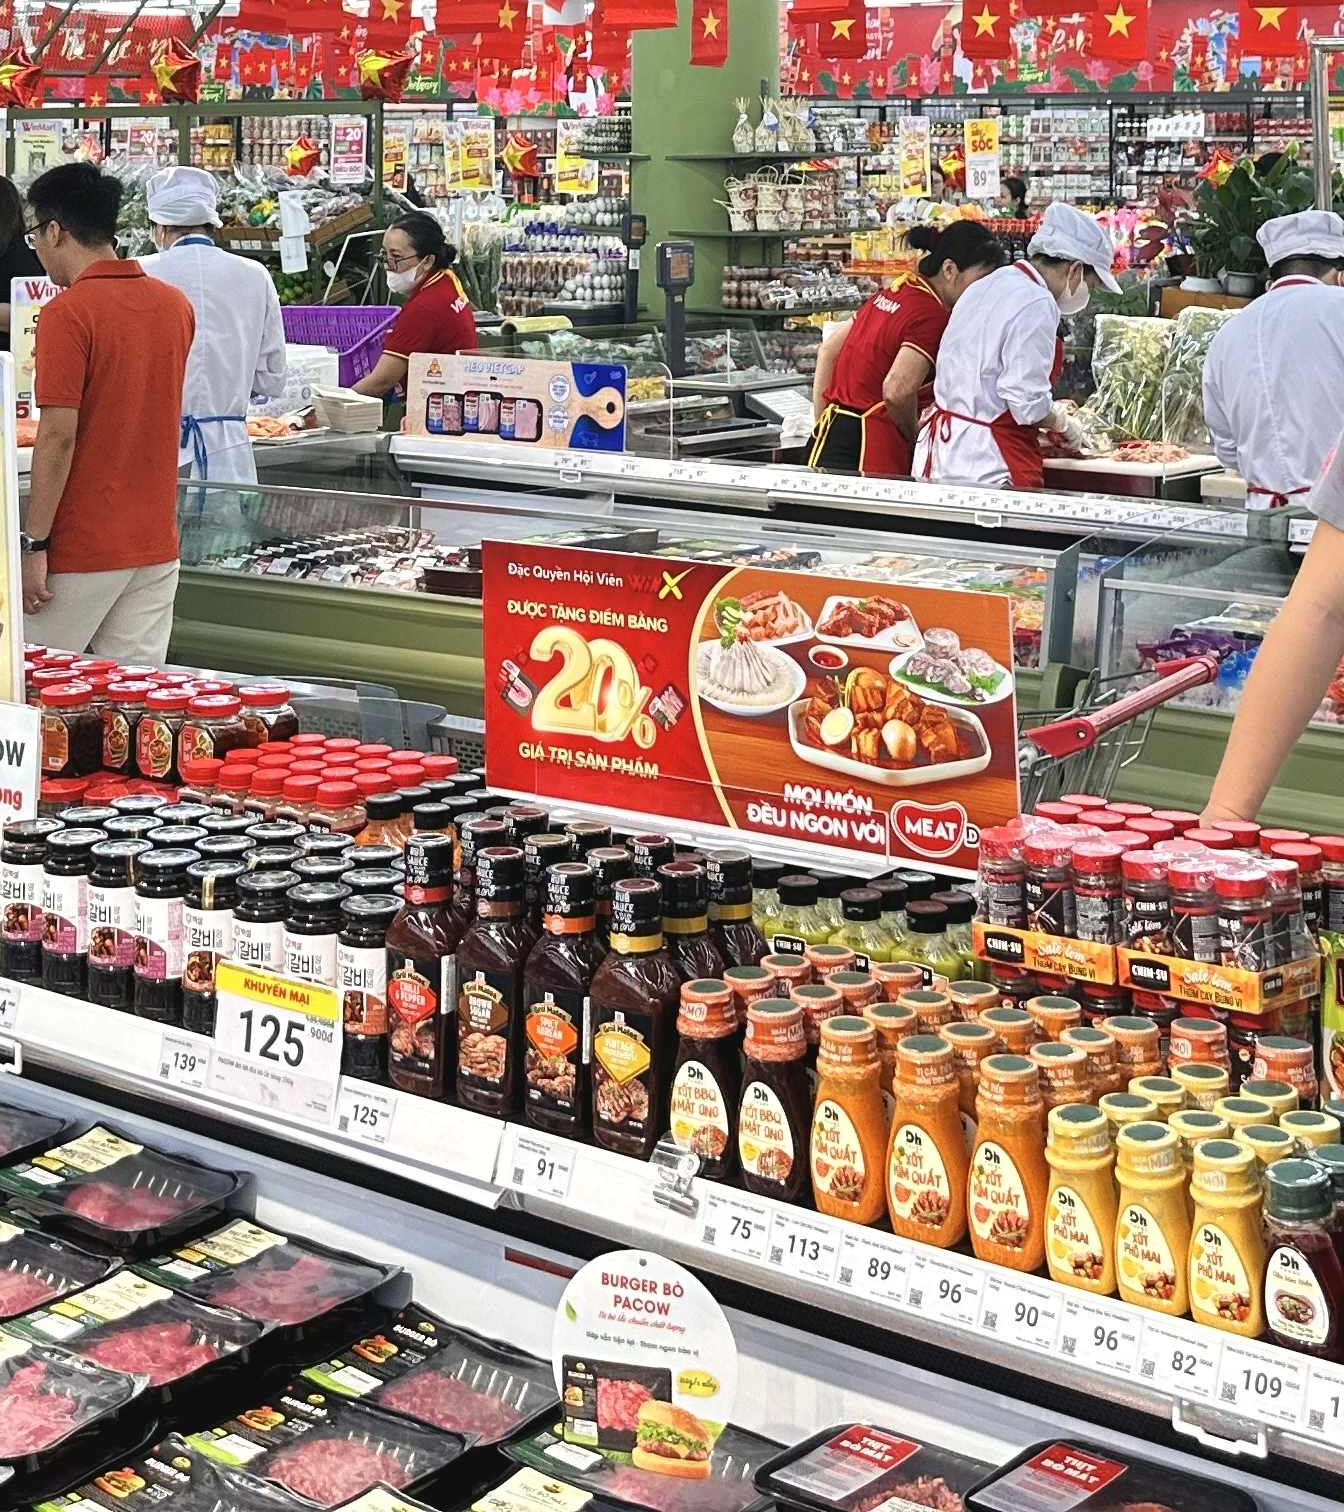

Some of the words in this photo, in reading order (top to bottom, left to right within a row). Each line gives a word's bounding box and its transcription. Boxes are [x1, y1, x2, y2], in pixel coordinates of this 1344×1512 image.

[507, 561, 531, 580] Đặc
[533, 564, 571, 586] Quyền
[573, 568, 594, 587] Hội
[596, 571, 624, 589] Viên
[506, 599, 547, 621] ĐƯỢC
[549, 600, 586, 626] TẶNG
[588, 605, 625, 628] ĐIỂM
[627, 610, 669, 634] BẰNG
[531, 625, 657, 750] 20%
[518, 740, 546, 761] GIÁ
[746, 800, 786, 831] ĐỀU
[790, 807, 849, 841] NGON
[851, 815, 885, 846] VỚI
[904, 812, 959, 844] MEAT
[986, 937, 1022, 954] CHIN-SU
[243, 976, 285, 1003] KHUYẾN
[288, 986, 311, 1007] MẠI
[238, 1008, 306, 1067] 125
[687, 1066, 704, 1081] Dh
[352, 1104, 379, 1126] 125
[536, 1157, 556, 1178] 91
[730, 1216, 752, 1240] 75
[786, 1234, 820, 1260] 113
[867, 1257, 892, 1281] 89
[601, 1272, 658, 1294] BURGER
[663, 1281, 685, 1298] BÒ
[938, 1279, 962, 1304] 96
[613, 1295, 671, 1316] PACOW
[1093, 1326, 1119, 1352] 96
[1171, 1352, 1197, 1376] 82
[1241, 1369, 1284, 1398] 109
